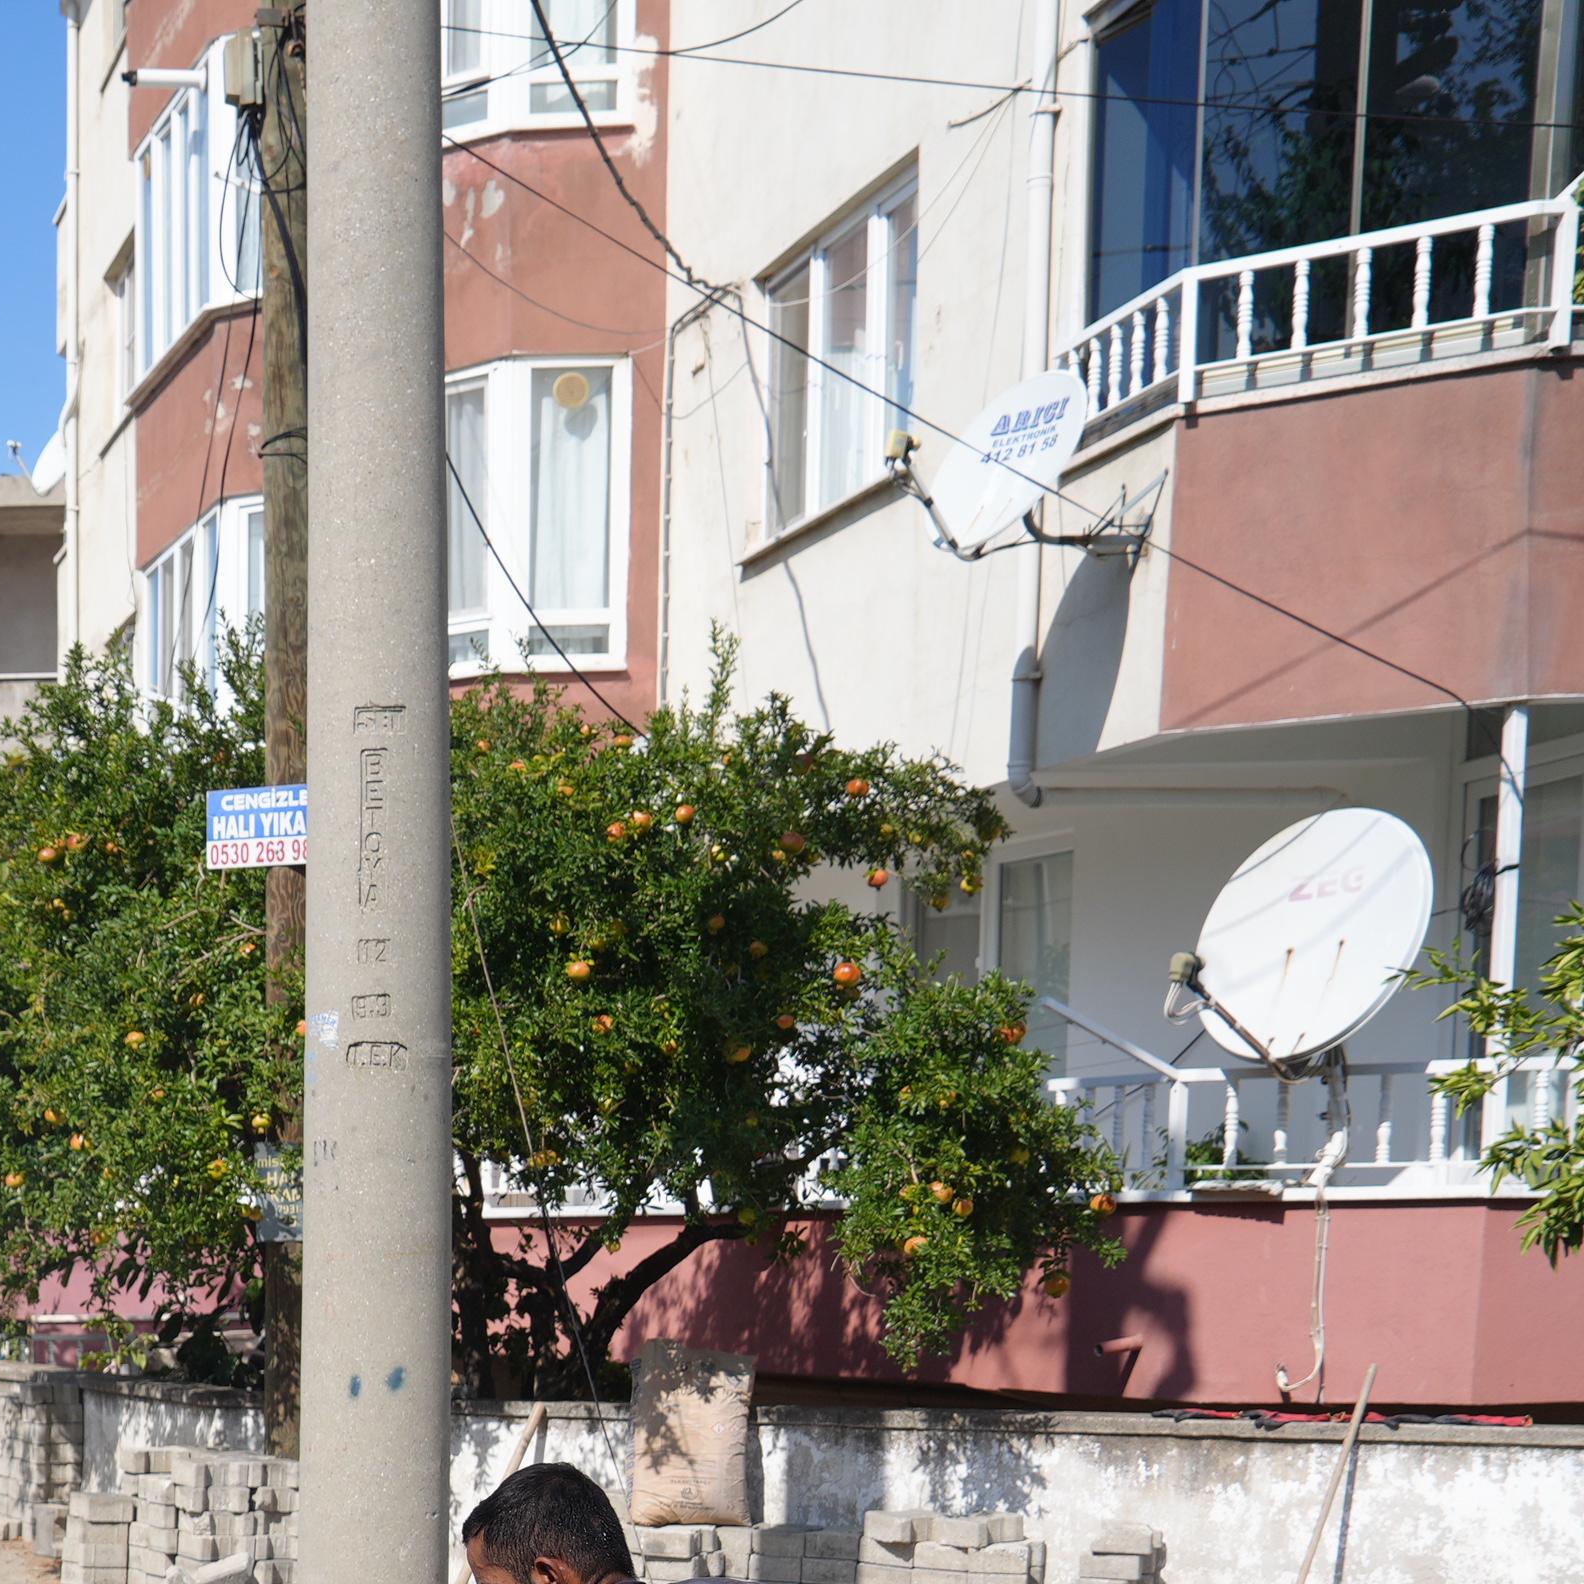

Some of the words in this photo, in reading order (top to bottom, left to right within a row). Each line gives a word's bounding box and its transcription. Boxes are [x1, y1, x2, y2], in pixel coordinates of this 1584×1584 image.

[213, 813, 256, 840] HALI
[259, 810, 306, 837] YIKA
[211, 842, 249, 865] 0530
[256, 840, 285, 863] 263
